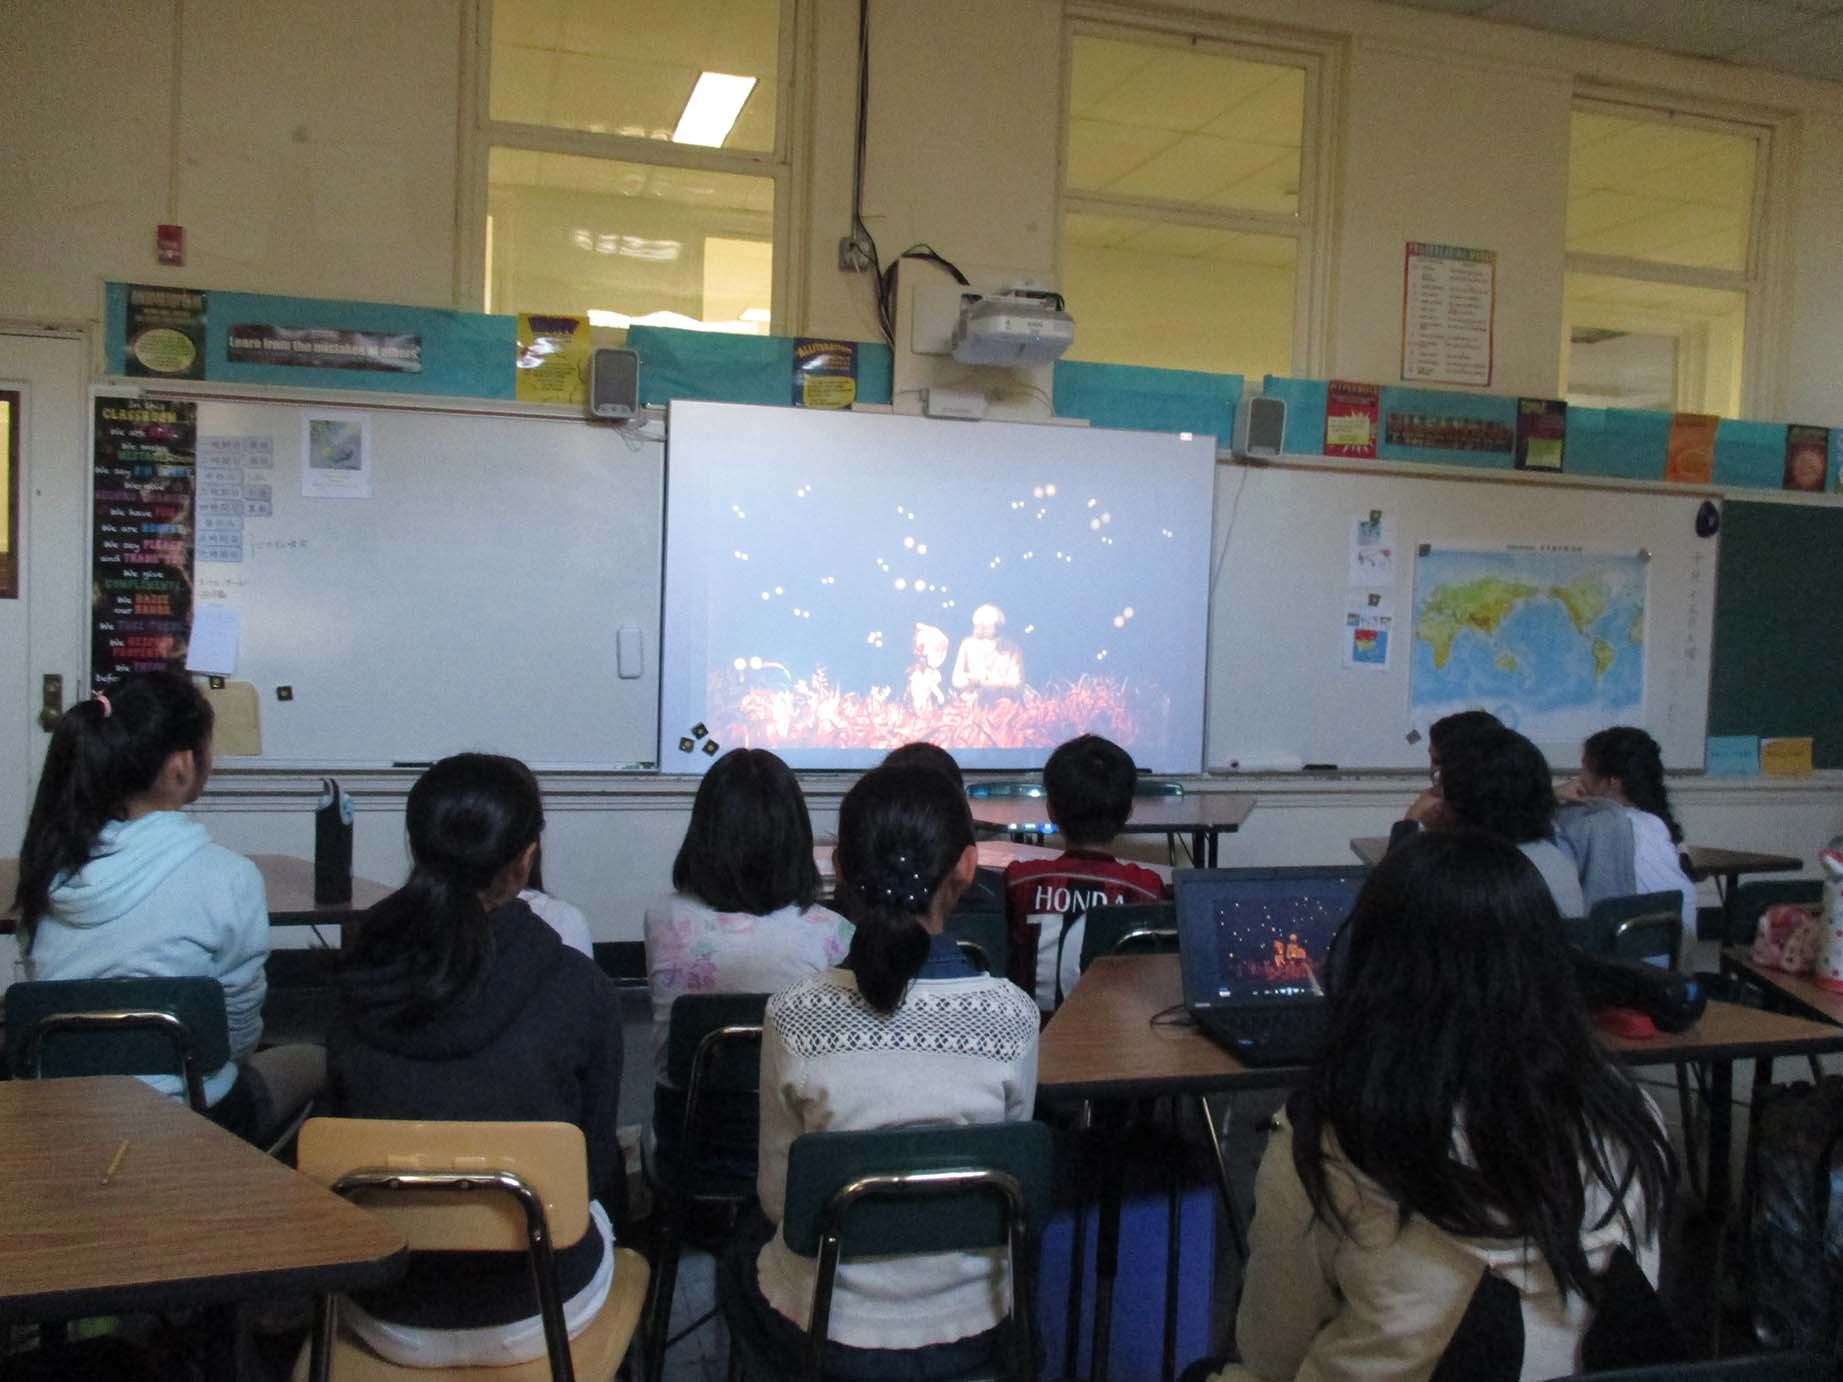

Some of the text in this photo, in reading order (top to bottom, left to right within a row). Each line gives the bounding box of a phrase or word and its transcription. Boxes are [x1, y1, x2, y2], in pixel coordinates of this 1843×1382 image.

[229, 336, 262, 350] Learn
[263, 338, 291, 351] from
[293, 341, 313, 352] the
[102, 408, 177, 423] CLASSROOM
[1035, 885, 1124, 913] HONDA
